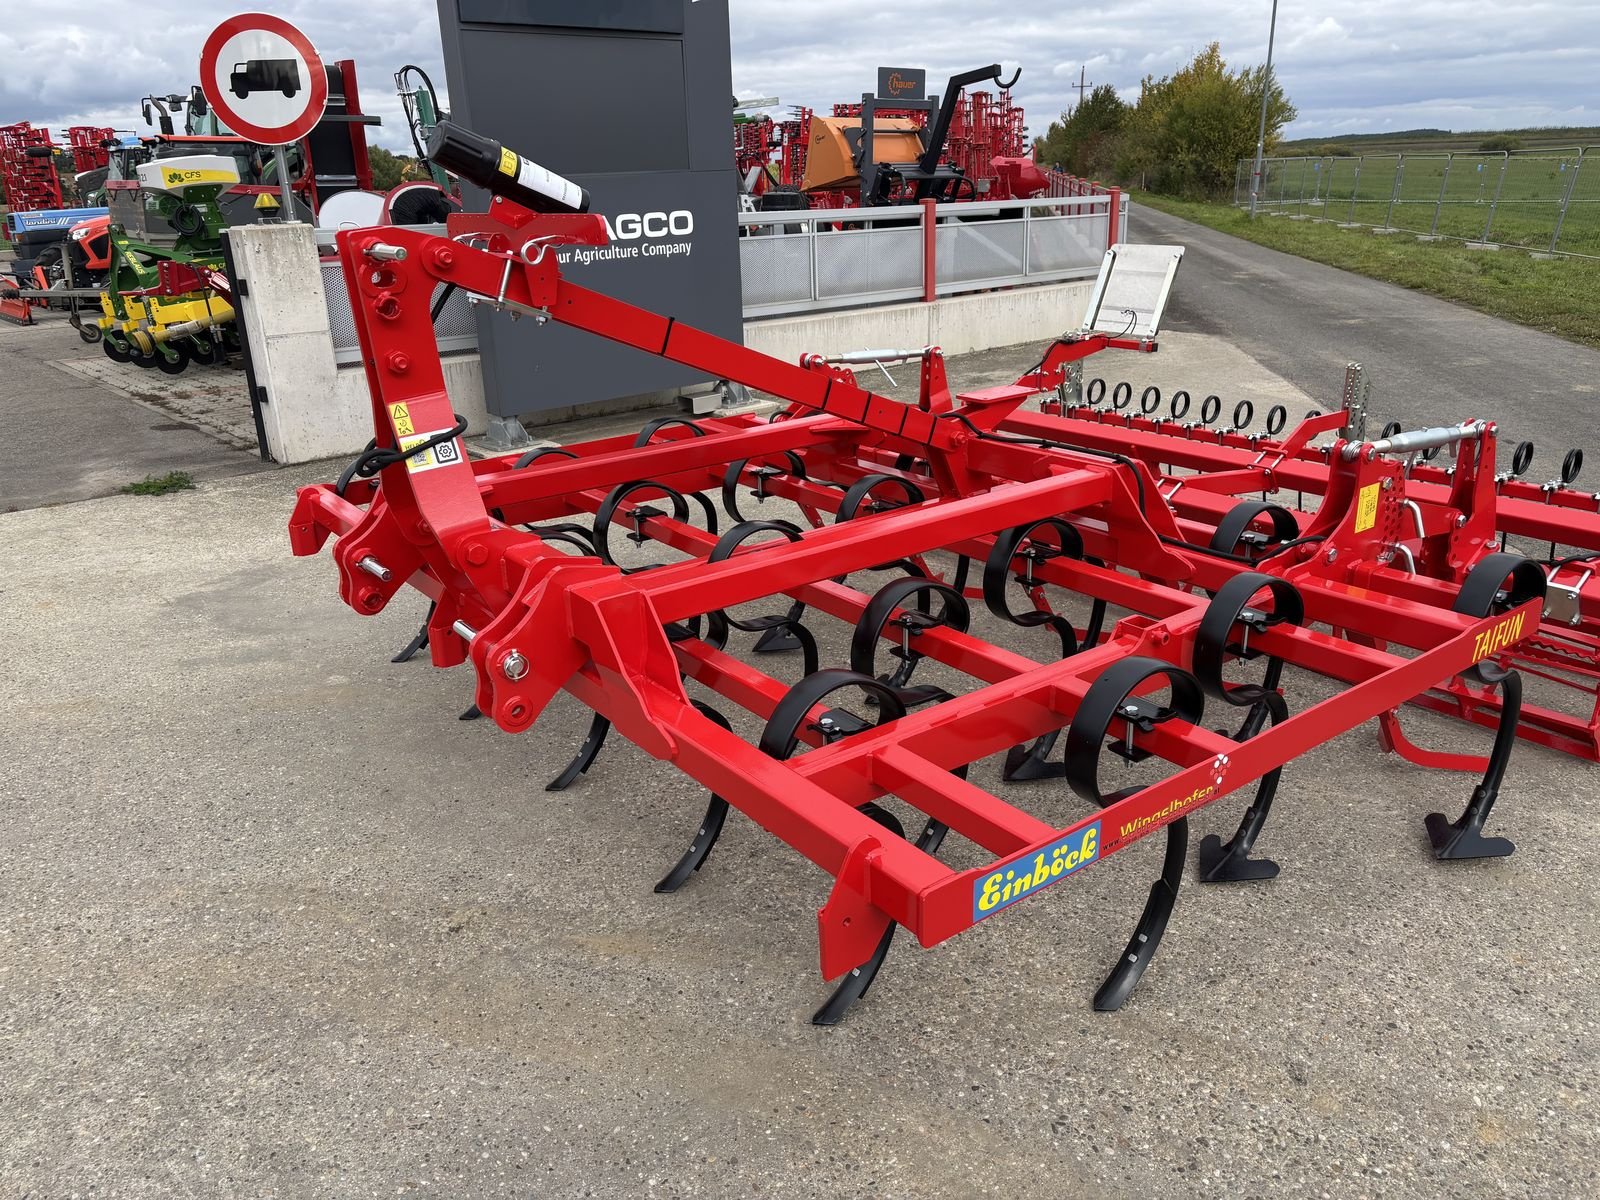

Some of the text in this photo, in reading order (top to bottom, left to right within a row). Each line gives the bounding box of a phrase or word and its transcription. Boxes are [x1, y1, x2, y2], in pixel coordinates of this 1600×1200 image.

[184, 171, 201, 179] CFS
[557, 242, 692, 265] ur Agriculture Company
[1472, 610, 1526, 663] TAIFUN
[978, 828, 1097, 911] Einböck
